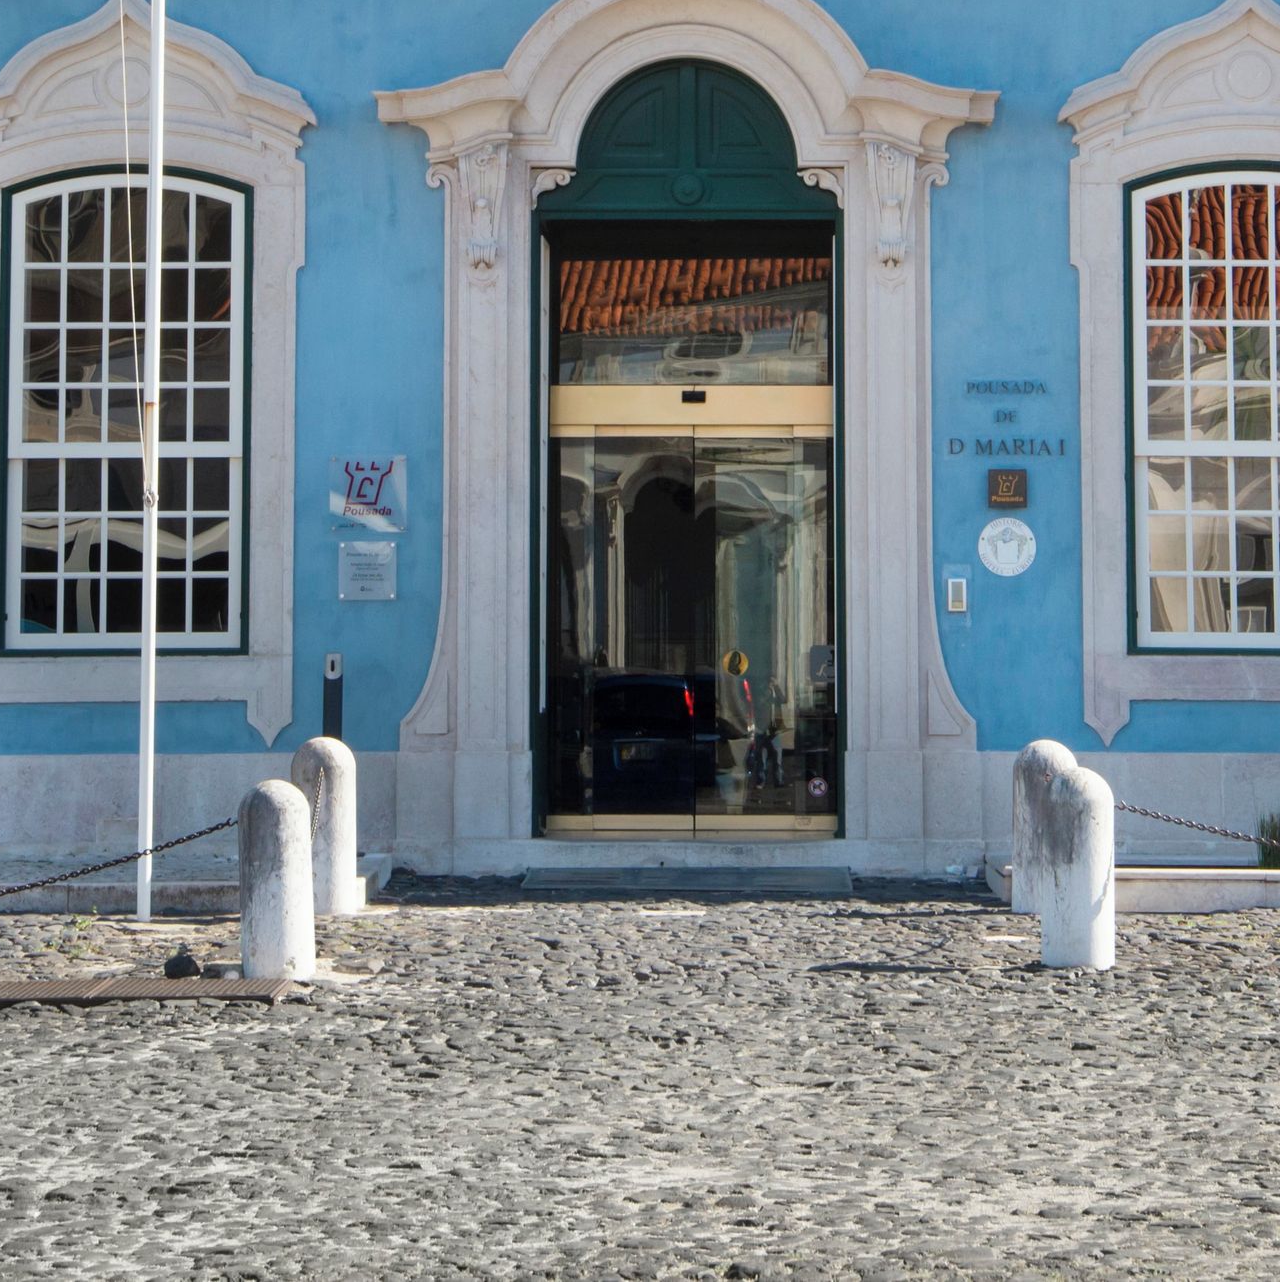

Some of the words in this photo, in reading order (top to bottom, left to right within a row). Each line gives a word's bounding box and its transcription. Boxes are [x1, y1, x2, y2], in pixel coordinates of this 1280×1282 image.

[966, 380, 1047, 395] POUSADA
[996, 409, 1017, 423] DE
[949, 438, 965, 455] D
[975, 438, 1051, 456] MARIA
[1058, 438, 1065, 456] I
[342, 505, 392, 516] Pousada
